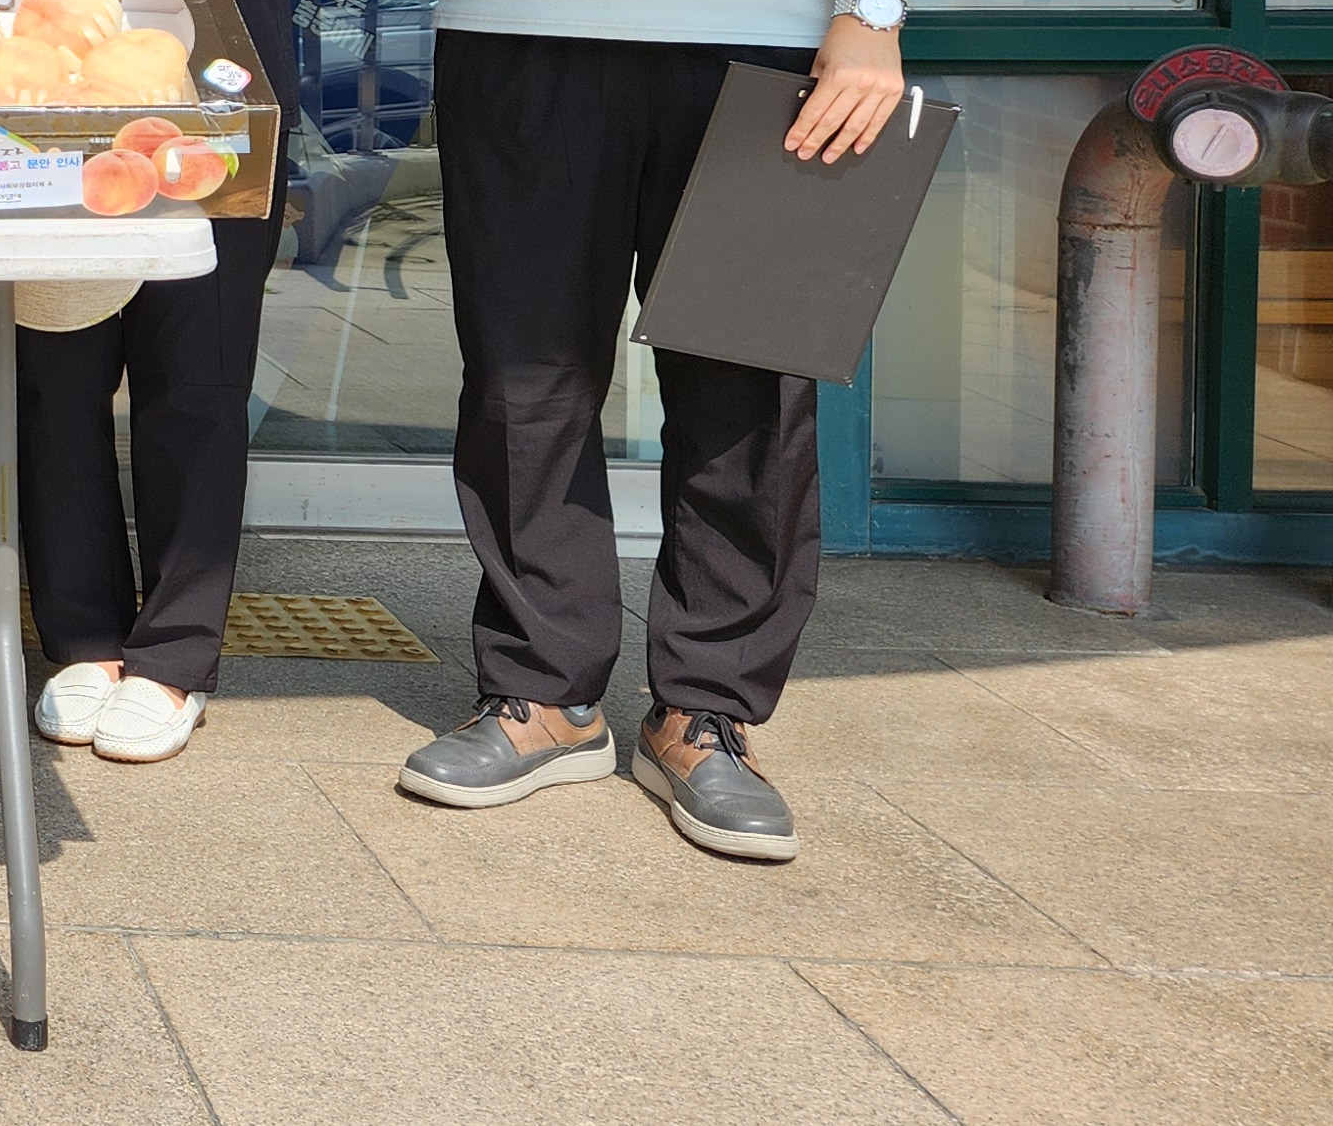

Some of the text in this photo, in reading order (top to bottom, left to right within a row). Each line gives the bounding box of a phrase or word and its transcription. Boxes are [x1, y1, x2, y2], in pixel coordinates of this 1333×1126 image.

[292, 0, 375, 59] 충분하게
[27, 158, 50, 170] 문안
[56, 156, 80, 168] 인사
